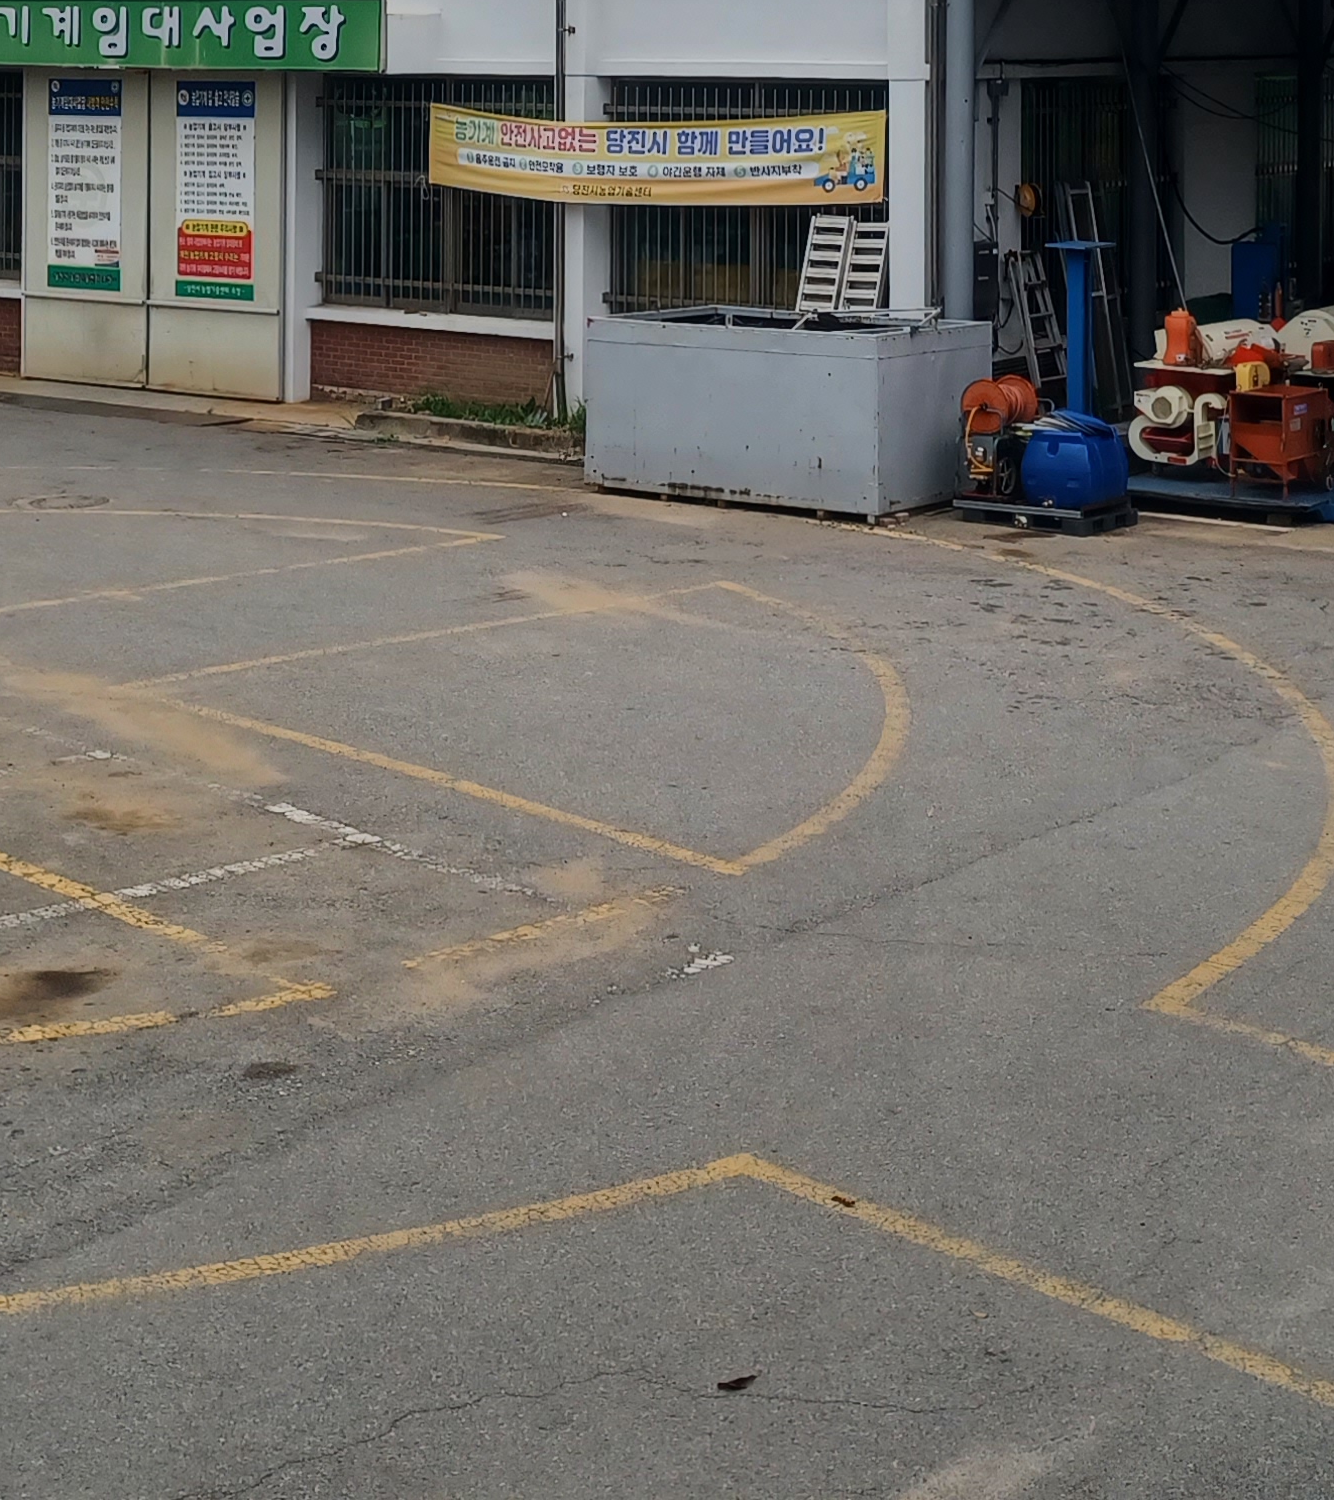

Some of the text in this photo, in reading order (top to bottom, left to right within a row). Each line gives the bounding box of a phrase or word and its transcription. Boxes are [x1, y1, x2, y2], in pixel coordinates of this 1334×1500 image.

[455, 118, 825, 155] 농기계 안전사고없는 당진시 함께 만들어요!
[618, 165, 638, 177] 보호
[705, 165, 726, 178] 자제
